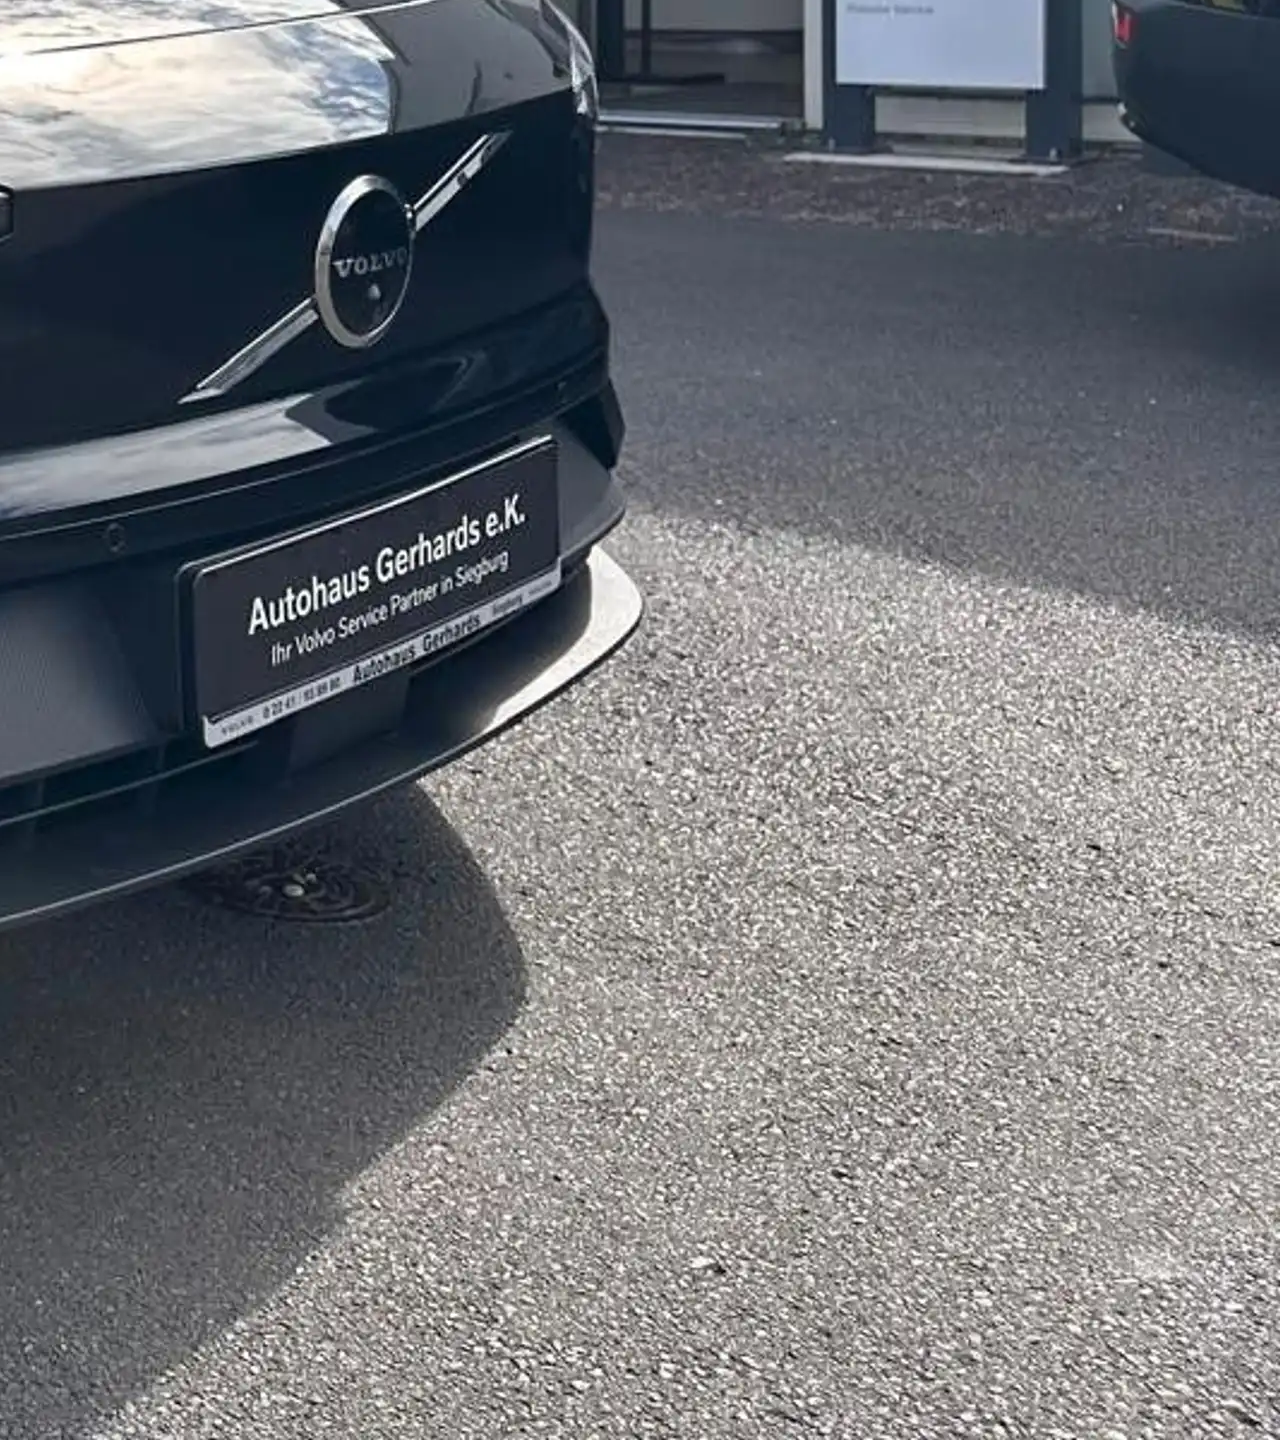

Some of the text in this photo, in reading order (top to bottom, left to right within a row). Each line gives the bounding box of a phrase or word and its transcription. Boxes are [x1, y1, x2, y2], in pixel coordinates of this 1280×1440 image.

[332, 247, 408, 278] VOLVO
[248, 493, 526, 635] Autohaus Gerhards e.K.
[271, 642, 293, 666] Ihr
[295, 627, 336, 655] Volvo
[338, 604, 389, 638] Service
[389, 582, 439, 616] Partner
[439, 574, 454, 595] in
[455, 551, 509, 588] Siegburg
[353, 645, 416, 683] Autohaus
[423, 614, 482, 652] Gerhards
